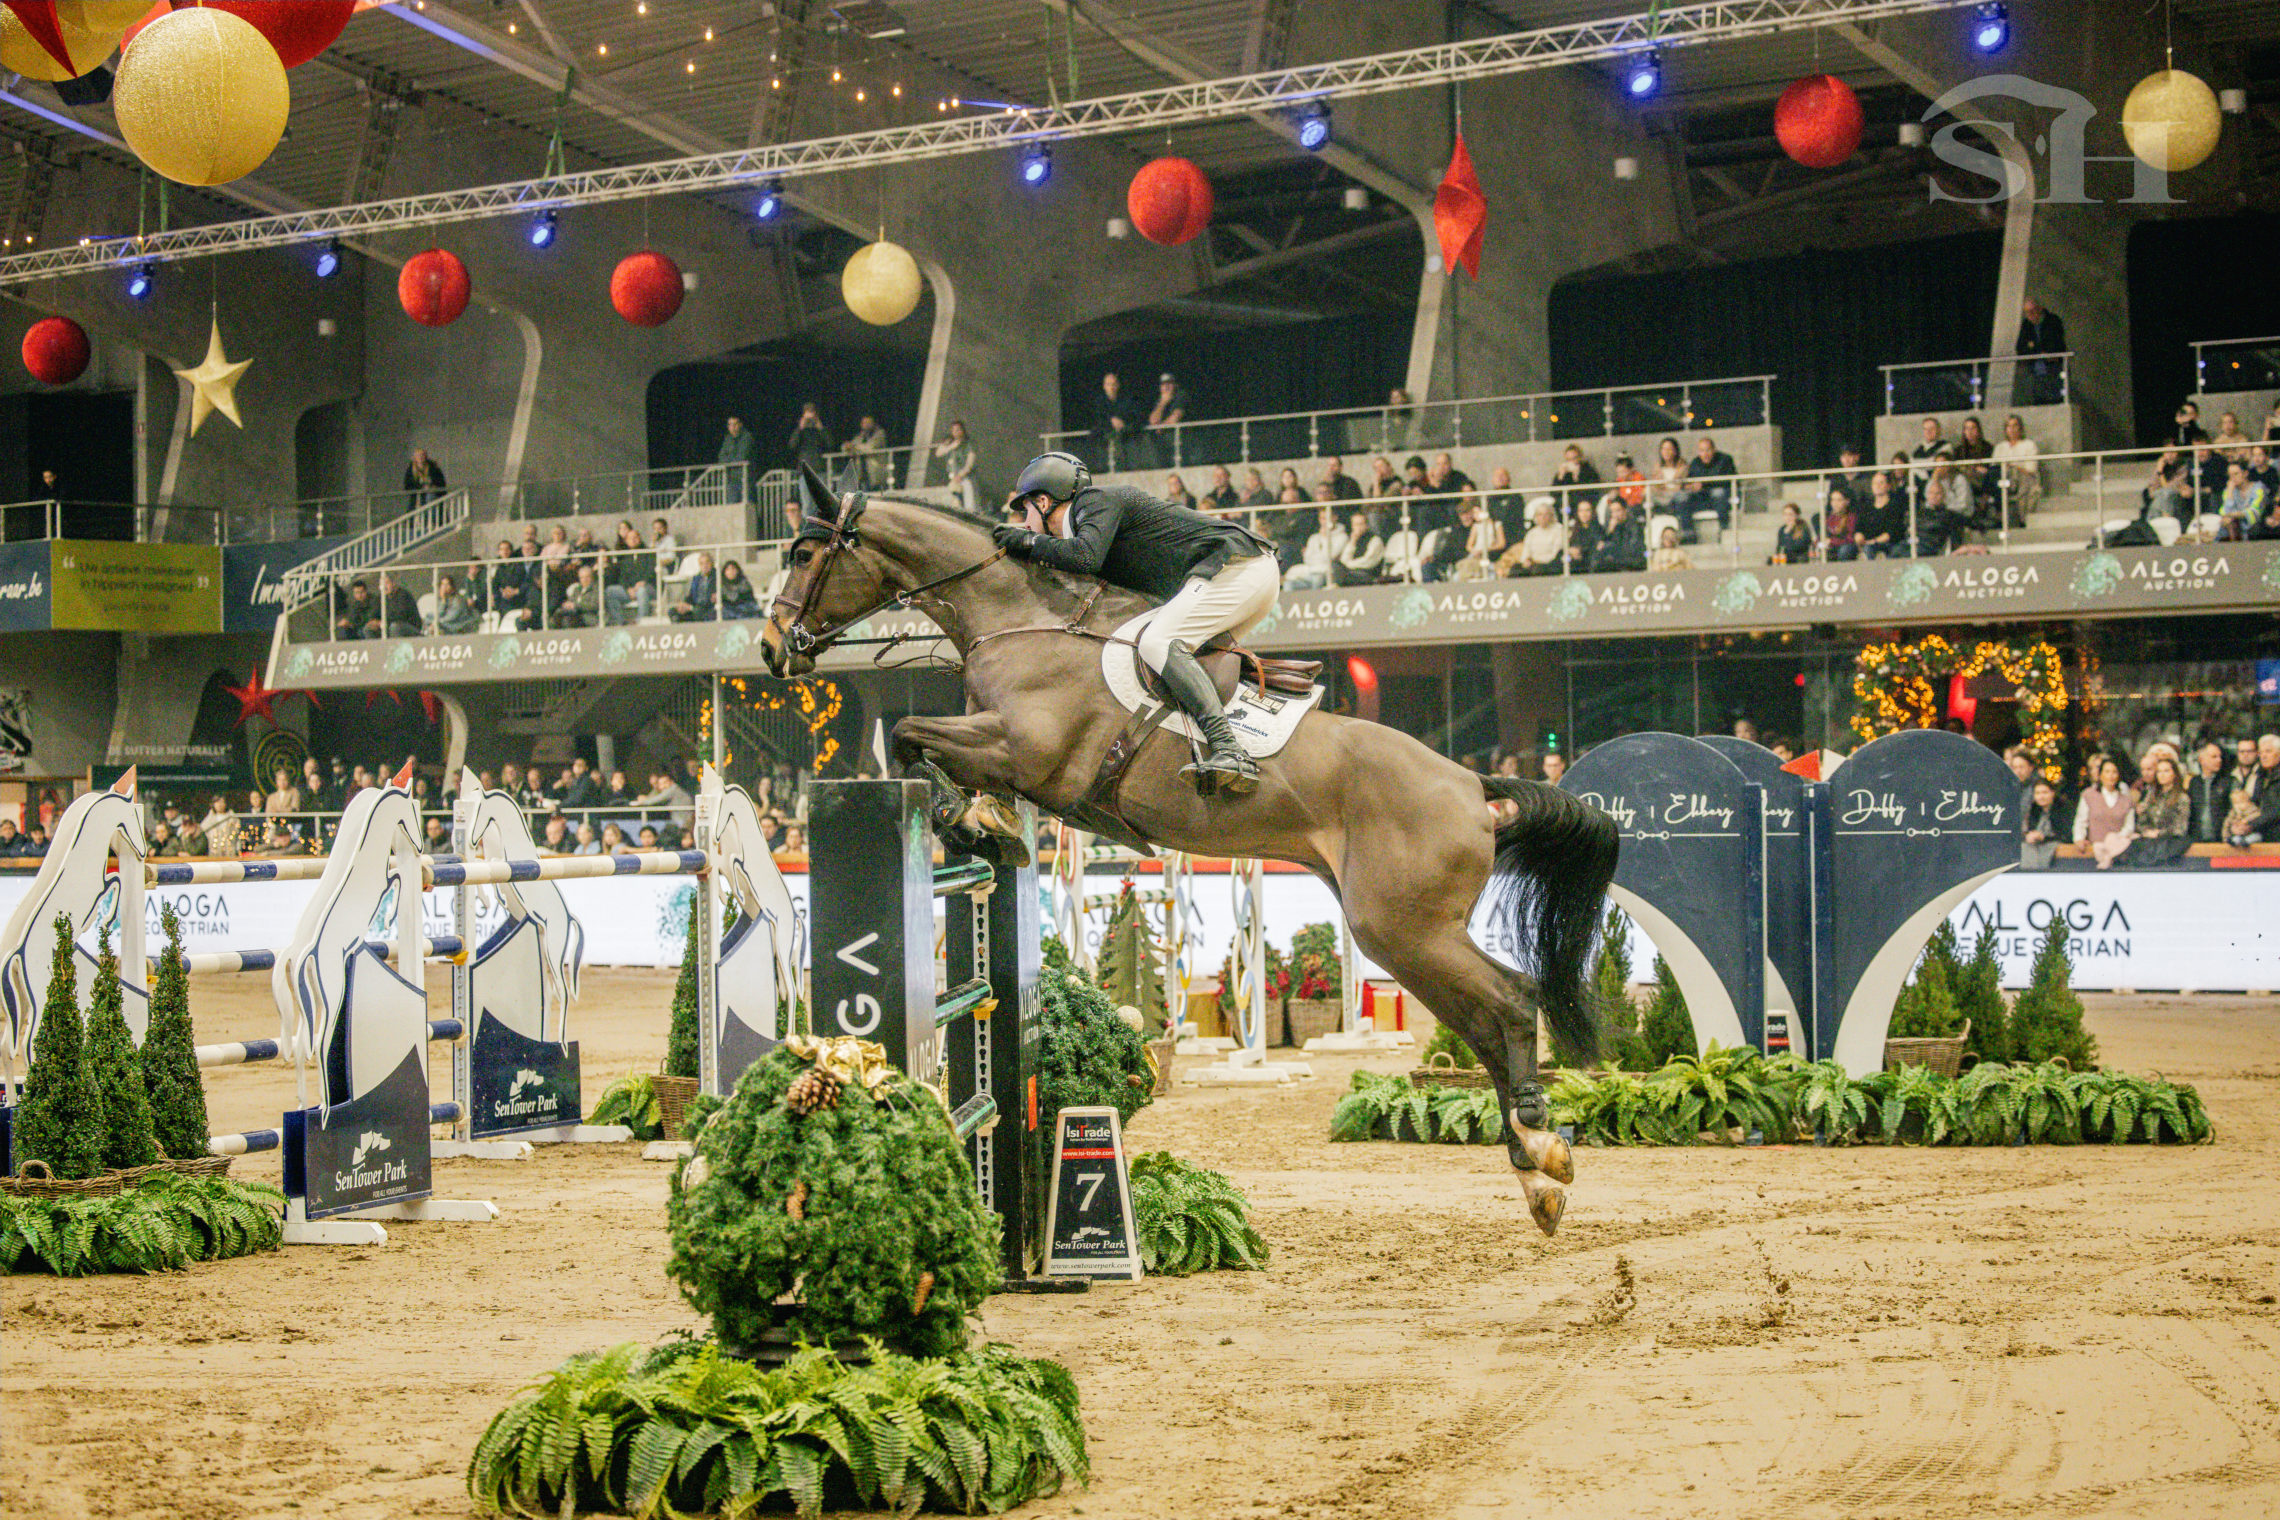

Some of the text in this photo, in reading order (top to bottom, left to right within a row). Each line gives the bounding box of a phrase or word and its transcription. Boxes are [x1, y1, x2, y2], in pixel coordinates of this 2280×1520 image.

[1944, 566, 2040, 587] ALOGA
[2130, 557, 2230, 579] ALOGA
[1599, 583, 1685, 603] ALOGA
[1767, 575, 1858, 596] ALOGA
[1957, 587, 2025, 599] AUCTION
[2144, 578, 2215, 591] AUCTION
[1287, 600, 1365, 619] ALOGA
[1439, 591, 1521, 611] ALOGA
[1610, 604, 1672, 615] AUCTION
[1779, 596, 1843, 607] AUCTION
[1297, 620, 1353, 630] AUCTION
[1449, 611, 1508, 622] AUCTION
[524, 639, 581, 656] ALOGA
[636, 633, 697, 650] ALOGA
[316, 650, 369, 666] ALOGA
[417, 645, 472, 661] ALOGA
[1961, 899, 2131, 932] ALOGA
[144, 920, 230, 935] EQSTRIAN
[1960, 937, 2131, 958] EUESRIAN
[494, 1092, 558, 1118] SenTower Park
[335, 1158, 407, 1192] SenTower Park
[1076, 1173, 1106, 1211] 7
[1054, 1239, 1126, 1250] SenTower Park
[1050, 1261, 1131, 1270] www.sentowerpark.com
